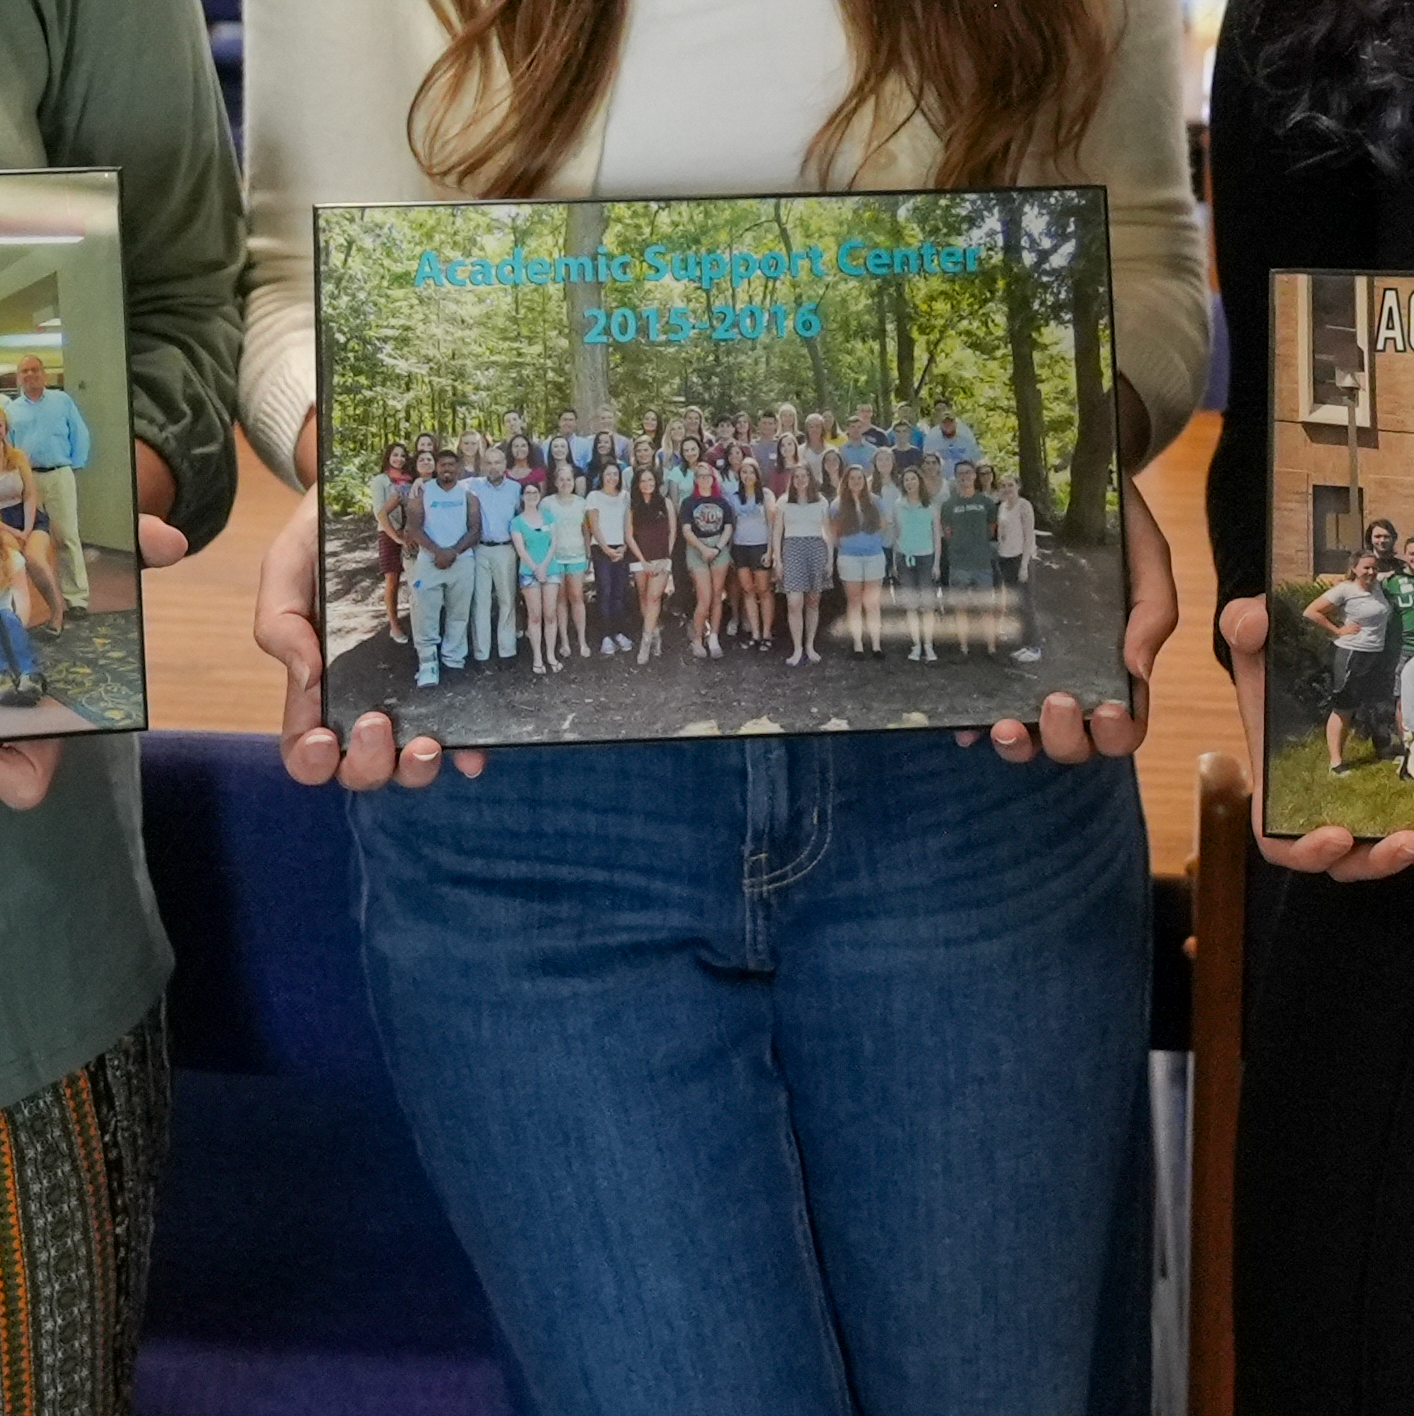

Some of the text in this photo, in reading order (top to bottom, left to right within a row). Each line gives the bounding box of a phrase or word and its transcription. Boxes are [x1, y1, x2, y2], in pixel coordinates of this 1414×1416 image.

[414, 239, 982, 290] Academic Support Center
[583, 301, 823, 344] 2015-2016
